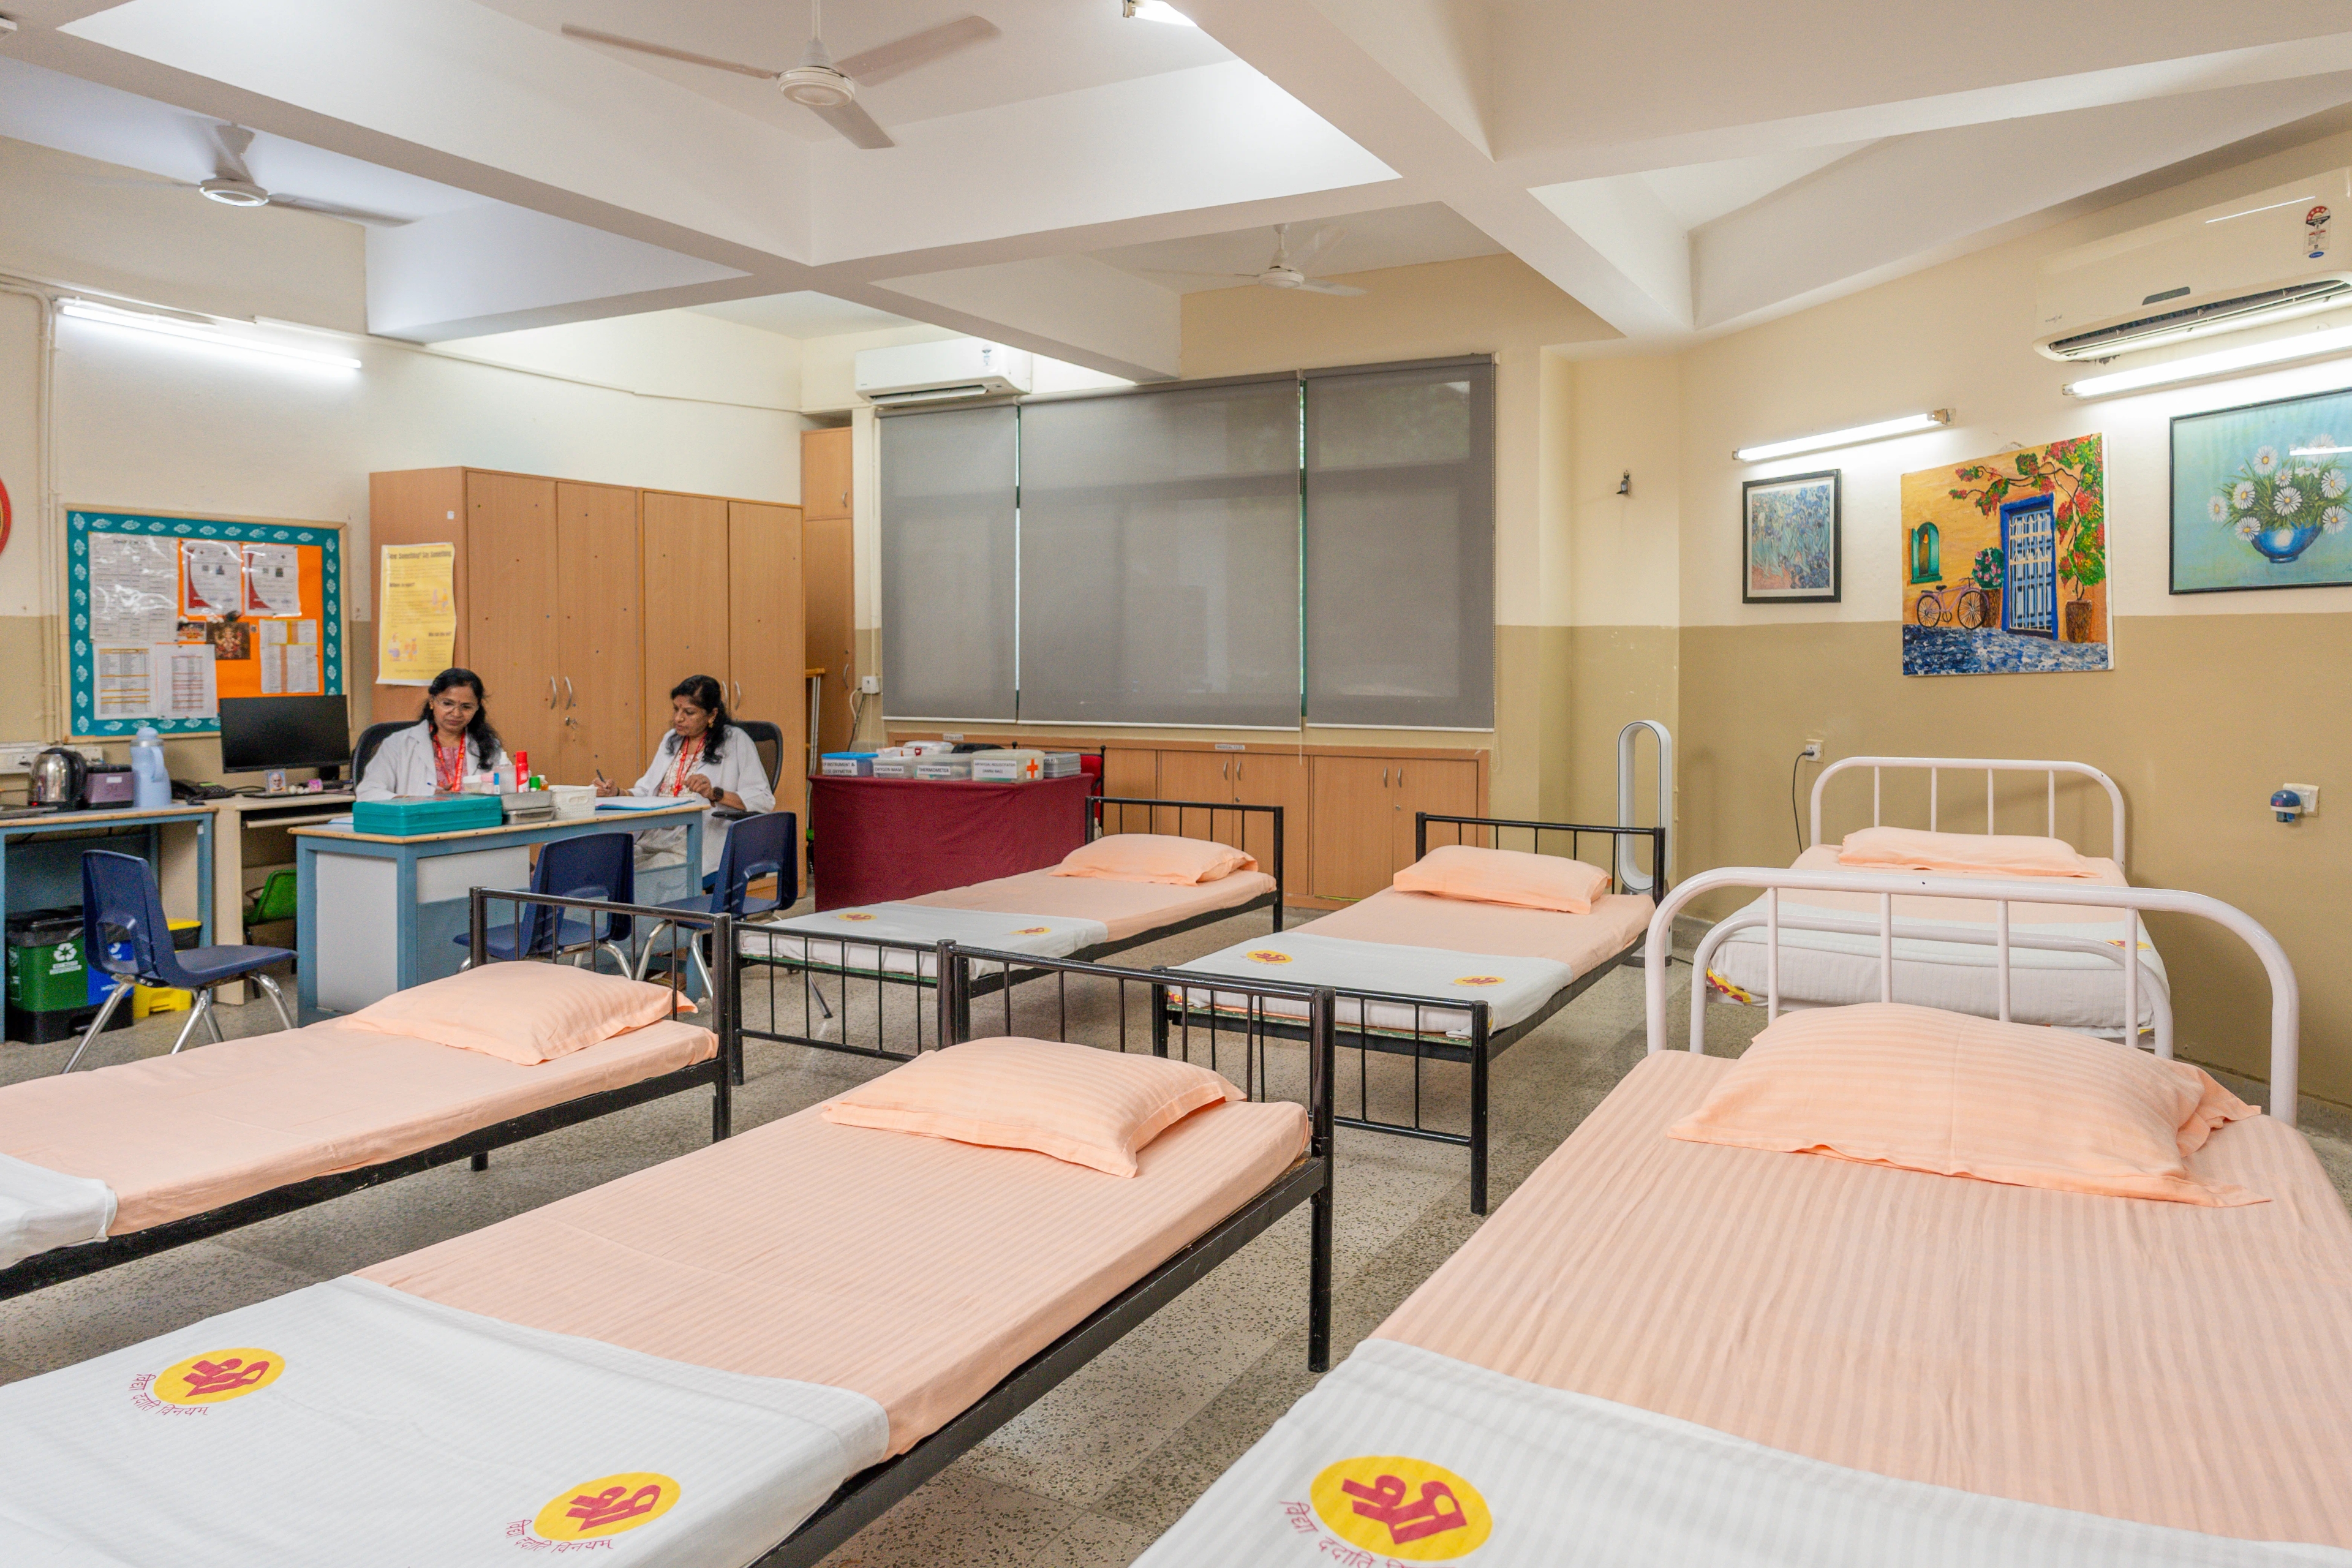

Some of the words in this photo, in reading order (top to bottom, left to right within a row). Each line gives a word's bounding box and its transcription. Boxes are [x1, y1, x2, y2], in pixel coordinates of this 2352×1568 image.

[128, 1373, 157, 1391] विद्या
[130, 1392, 162, 1411] ददाति
[155, 1404, 211, 1417] विनयम्
[1279, 1500, 1319, 1534] विद्या
[514, 1536, 553, 1551] ददाति
[550, 1538, 614, 1554] विनयम्
